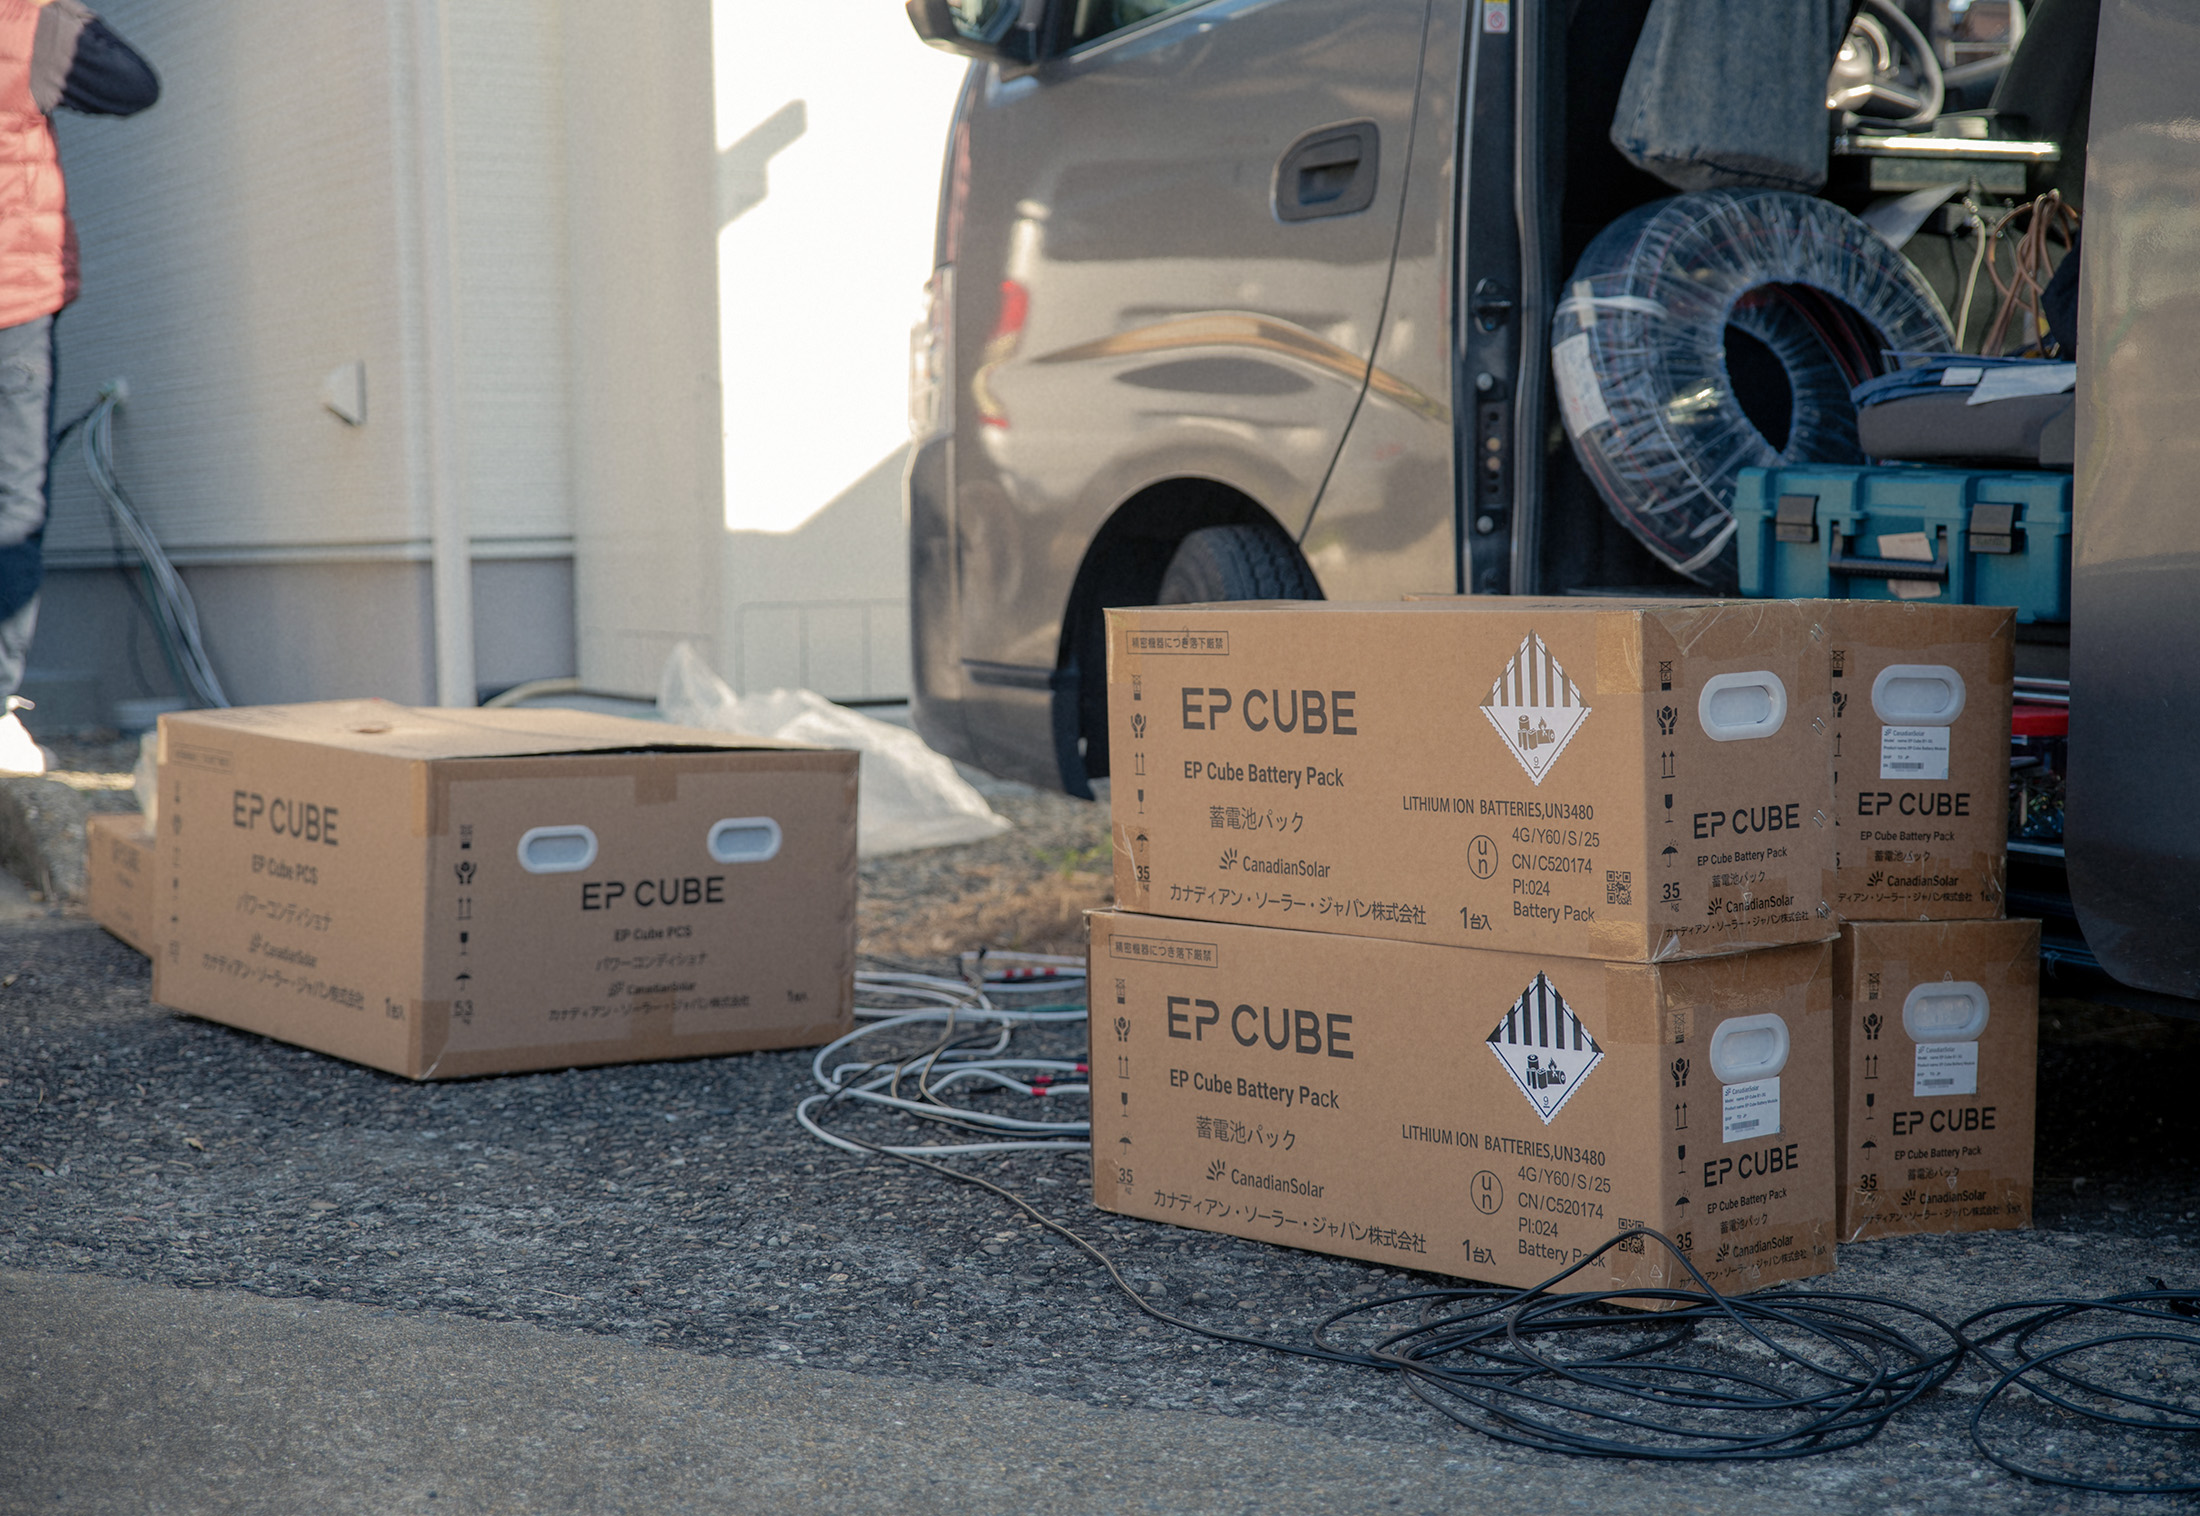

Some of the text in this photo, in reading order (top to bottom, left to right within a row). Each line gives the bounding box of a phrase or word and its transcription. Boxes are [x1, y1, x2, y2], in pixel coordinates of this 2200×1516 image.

[1182, 687, 1358, 736] EP CUBE
[1184, 761, 1344, 789] EP Cube Battery Pack
[1403, 796, 1450, 812] LITHIUM
[1452, 798, 1474, 814] ION
[1858, 792, 1971, 816] EP CUBE
[233, 790, 339, 846] EP CUBE
[1210, 805, 1304, 833] 蓄電池パック
[1694, 803, 1801, 840] EP CUBE
[1512, 827, 1600, 848] 4G/Y60/S/25
[1860, 831, 1955, 843] EP Cube Battery Pack
[1242, 856, 1330, 878] CanadianSolar
[1512, 854, 1593, 874] CN/C520174
[1698, 846, 1788, 867] EP Cube Battery Pack
[1136, 865, 1150, 880] 35
[1887, 875, 1959, 887] CanadianSolar
[582, 876, 726, 910] EP CUBE
[1662, 882, 1680, 900] 35
[1170, 884, 1426, 925] カナディアン・ソーラー・ジャパン株式会社
[1513, 901, 1595, 923] Battery Pack
[1726, 895, 1794, 914] CanadianSolar
[614, 924, 693, 942] EP Cube PCS
[1167, 996, 1354, 1060] EP CUBE
[1170, 1068, 1340, 1109] EP Cube Battery Pack
[1542, 1096, 1550, 1106] 9
[1196, 1115, 1296, 1151] 蓄電池パック
[1892, 1106, 1996, 1136] EP CUBE
[1402, 1124, 1452, 1145] LITHIUM
[1456, 1131, 1479, 1150] ION
[1894, 1146, 1982, 1160] EP Cube Battery Pack
[1119, 1168, 1133, 1183] 35
[1704, 1144, 1799, 1188] EP CUBE
[1231, 1168, 1325, 1198] CanadianSolar
[1518, 1166, 1611, 1193] 4G/Y60/S/25
[1860, 1174, 1876, 1189] 35
[1518, 1192, 1604, 1220] CN/C520174
[1707, 1188, 1787, 1214] EP Cube Battery Pack
[1920, 1190, 1986, 1204] CanadianSolar
[1154, 1190, 1427, 1254] カナディアン・ソーラー・ジャパン株式会社
[1519, 1239, 1568, 1265] Battery
[1676, 1232, 1692, 1250] 35
[1733, 1235, 1794, 1258] CanadianSolar
